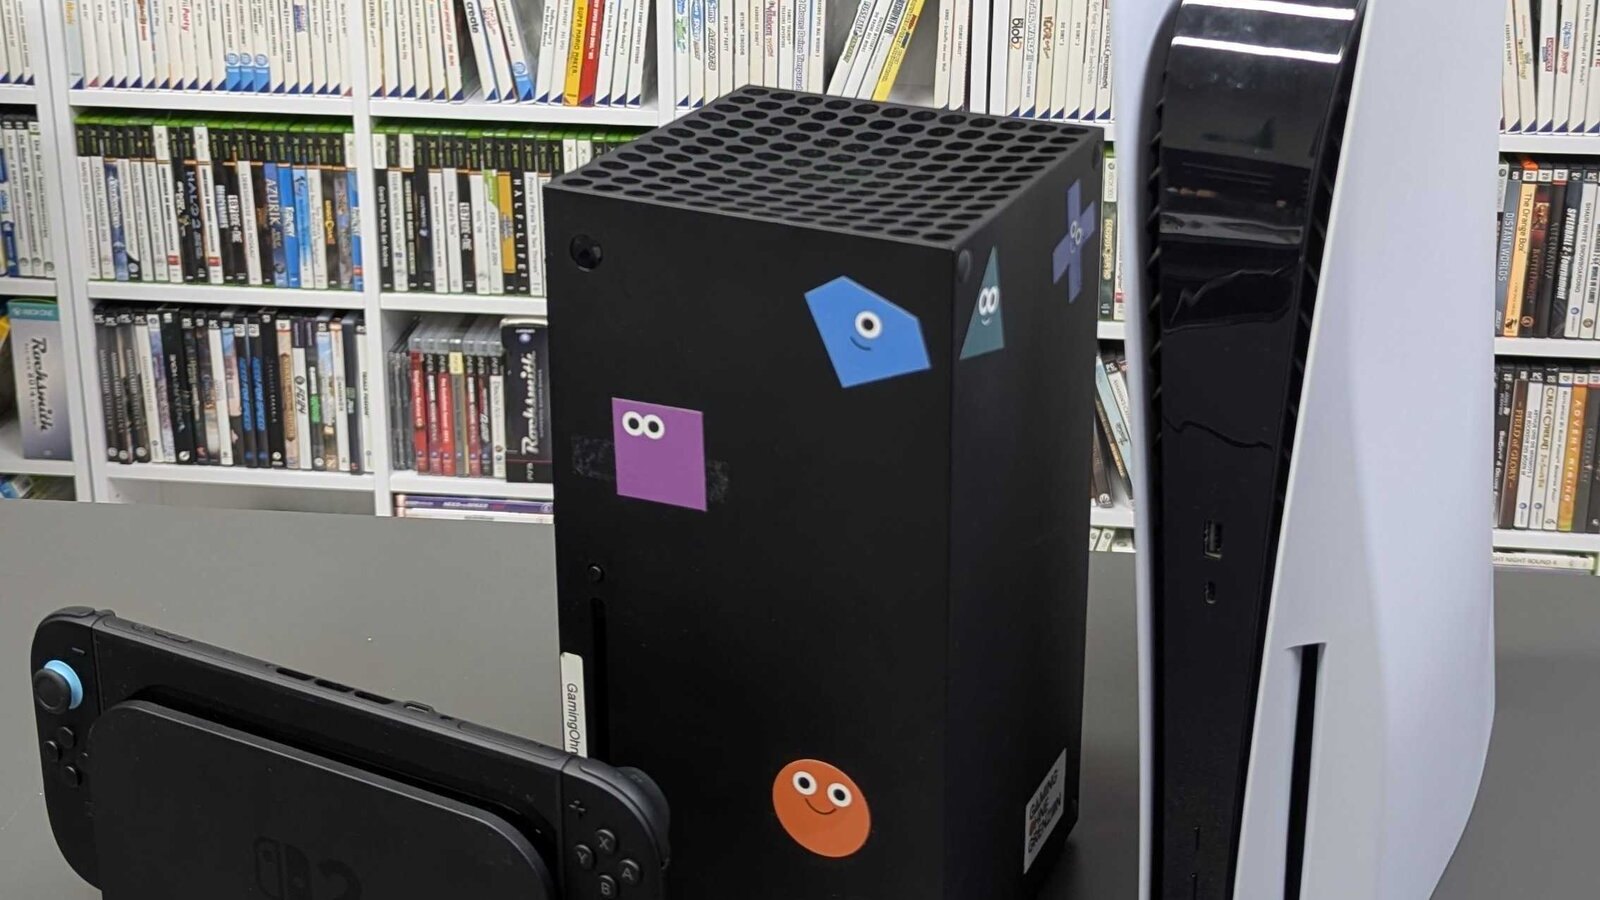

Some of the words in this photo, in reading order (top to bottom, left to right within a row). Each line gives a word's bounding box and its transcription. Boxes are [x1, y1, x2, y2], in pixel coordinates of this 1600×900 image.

[182, 8, 190, 31] Party
[467, 2, 479, 33] create
[576, 7, 584, 27] SUPER
[186, 171, 198, 216] HALO
[192, 218, 200, 230] 2
[266, 179, 281, 226] AZURIK
[1524, 193, 1532, 208] The
[1583, 202, 1592, 223] SHAUN
[1503, 212, 1514, 246] DISTANT
[1519, 208, 1530, 237] Orange
[1562, 208, 1577, 245] SPEEDBALL
[1581, 224, 1589, 242] WHITE
[1501, 248, 1512, 282] WORLDS
[1557, 255, 1572, 300] Tournament
[1575, 244, 1587, 292] SNOWBOARDING
[31, 337, 54, 432] Rocksmith
[242, 382, 251, 399] FOR
[255, 382, 264, 399] FOR
[1546, 387, 1554, 408] CALL
[243, 399, 252, 431] SPEED
[256, 399, 265, 431] SPEED
[1512, 409, 1523, 438] FIELD
[1570, 400, 1582, 454] ADVENT
[1512, 439, 1518, 449] of
[1508, 450, 1518, 480] GLORY
[576, 850, 587, 865] Y
[598, 836, 610, 851] X
[621, 867, 634, 881] A
[600, 882, 610, 896] B
